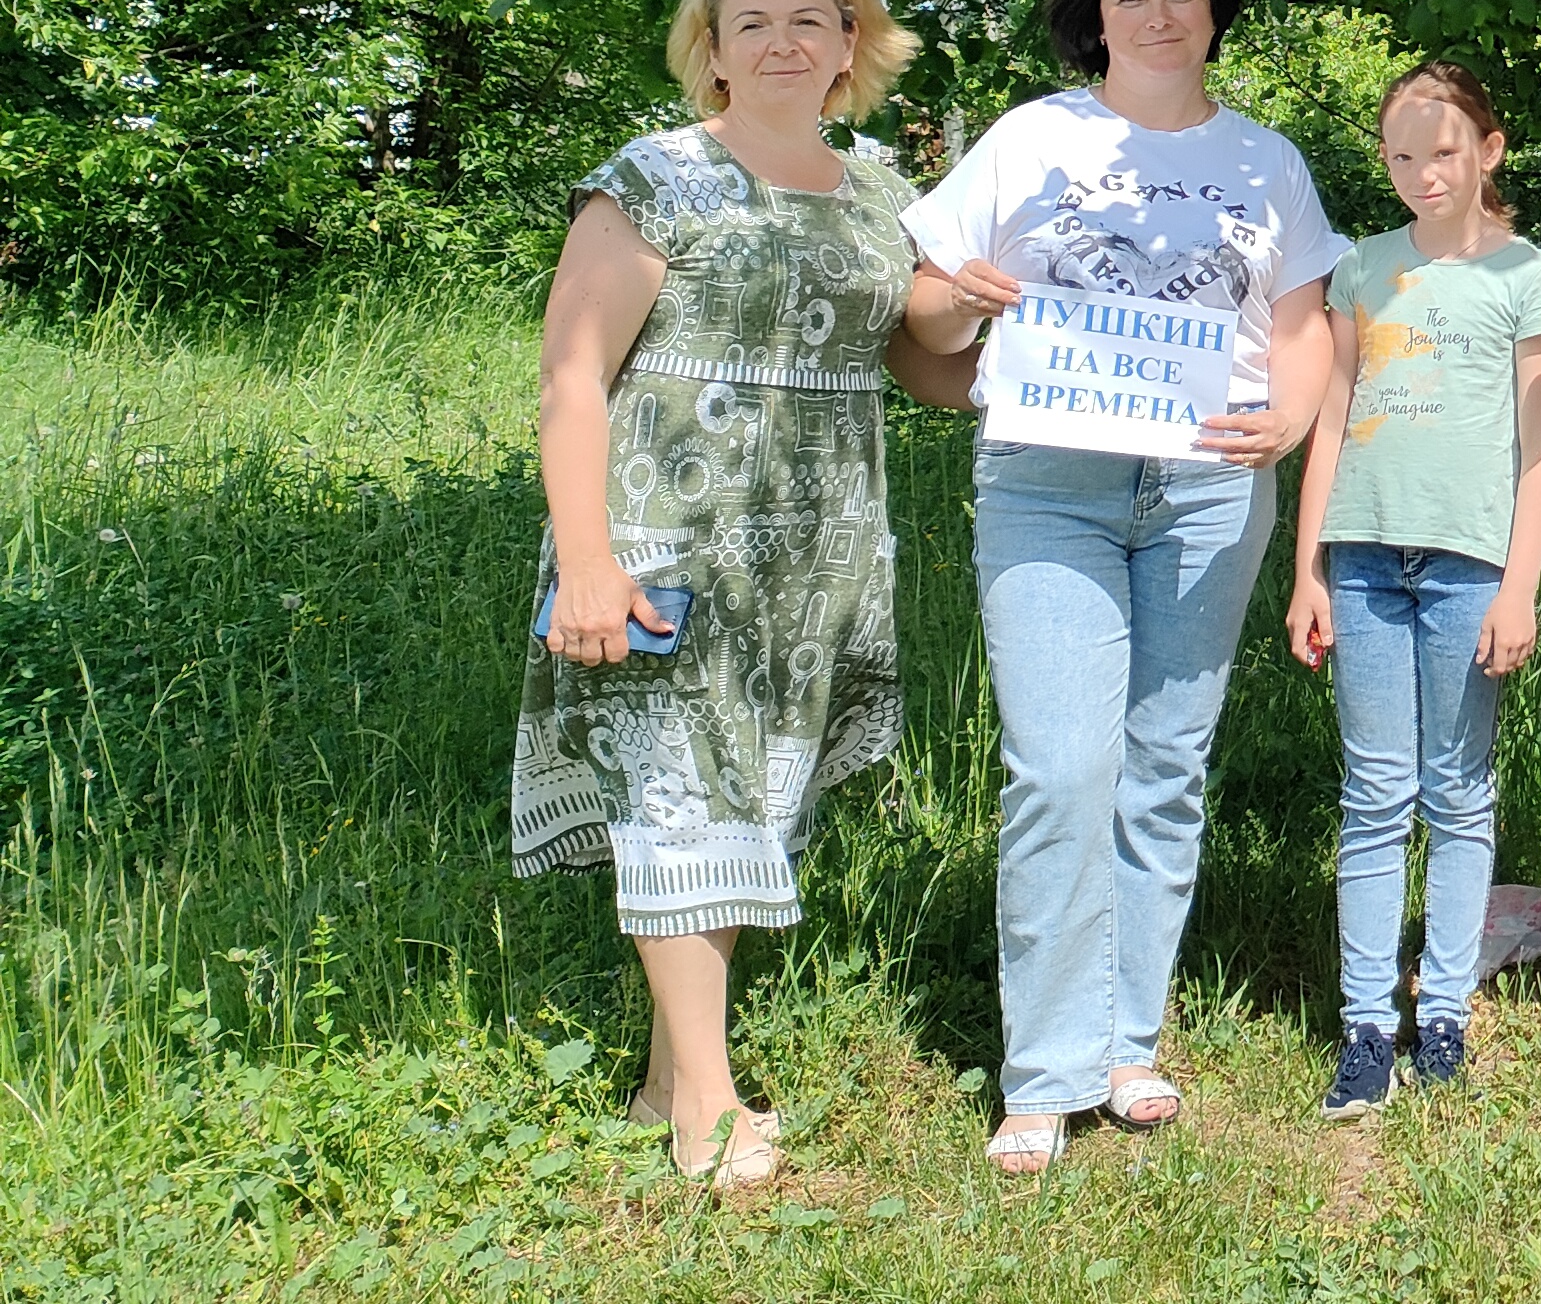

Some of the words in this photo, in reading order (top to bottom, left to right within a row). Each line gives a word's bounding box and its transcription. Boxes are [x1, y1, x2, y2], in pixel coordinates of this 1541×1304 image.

[1011, 296, 1228, 353] ПУШКИН
[1426, 307, 1450, 327] The
[1404, 326, 1474, 354] Journey
[1046, 345, 1100, 374] НА
[1111, 352, 1183, 385] ВСЕ
[1432, 346, 1445, 361] is
[1019, 382, 1200, 425] ВРЕМЕНА
[1379, 385, 1411, 403] yours
[1367, 403, 1379, 415] to
[1383, 398, 1446, 421] Imagine
